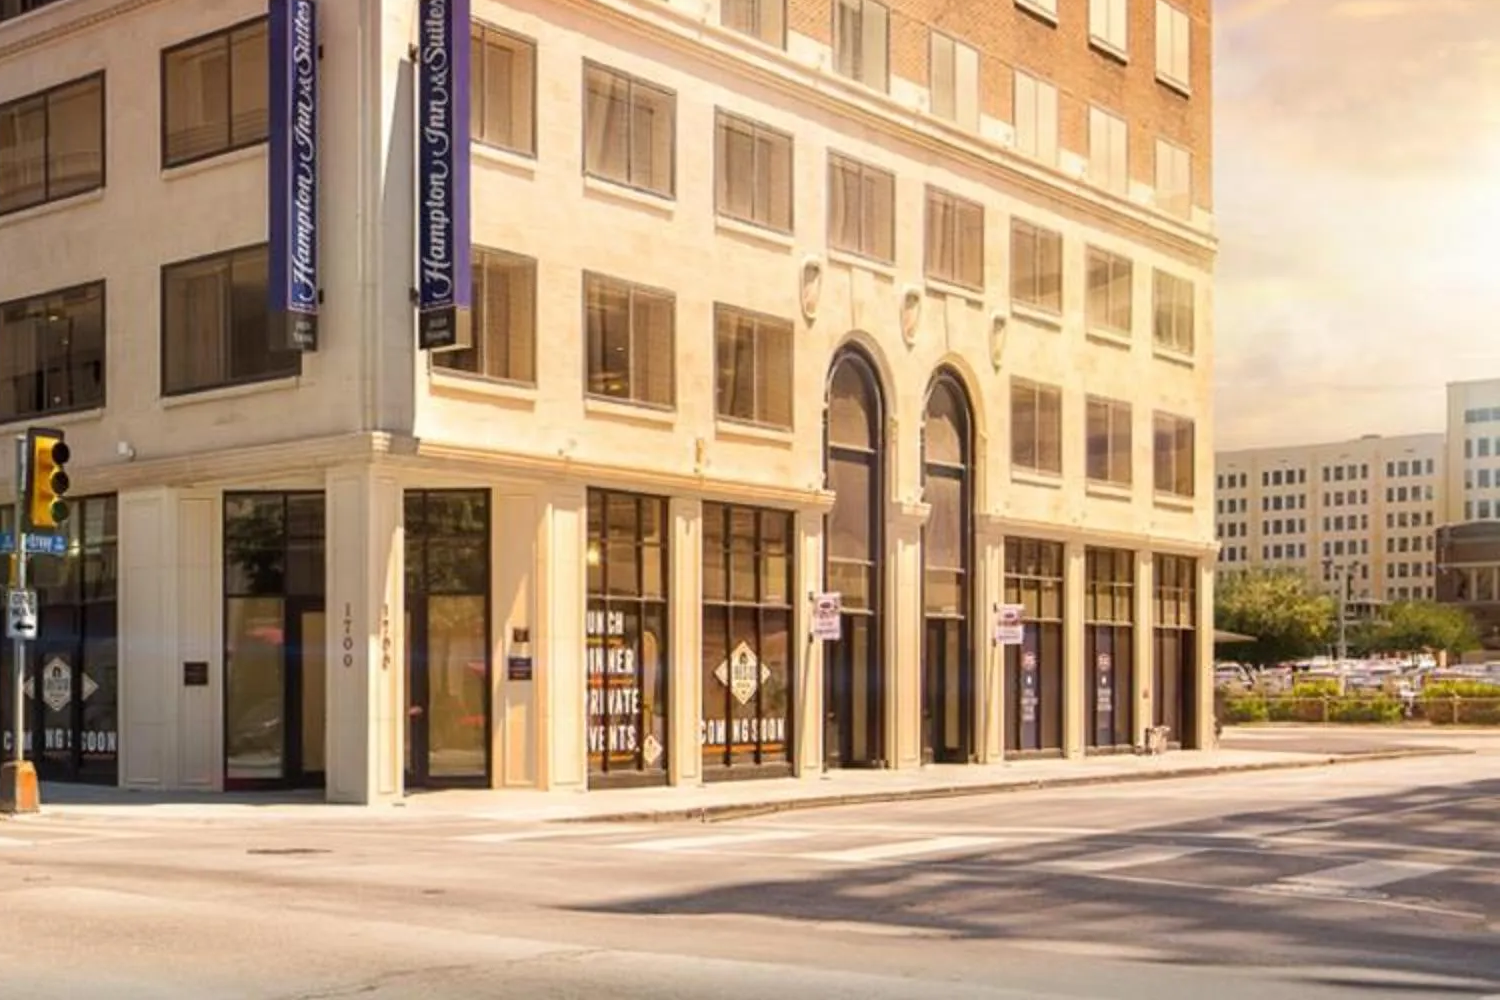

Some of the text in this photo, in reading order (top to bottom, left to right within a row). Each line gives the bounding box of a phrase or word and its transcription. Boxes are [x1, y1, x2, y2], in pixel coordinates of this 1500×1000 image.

[294, 0, 312, 75] Suites
[292, 160, 315, 302] Hampton
[422, 158, 452, 299] Hampton
[342, 601, 354, 668] 1700
[587, 610, 624, 635] UNCH
[587, 647, 634, 674] INNER
[587, 687, 640, 716] RIVATE
[3, 728, 64, 751] CMNG
[699, 718, 749, 745] COMNG
